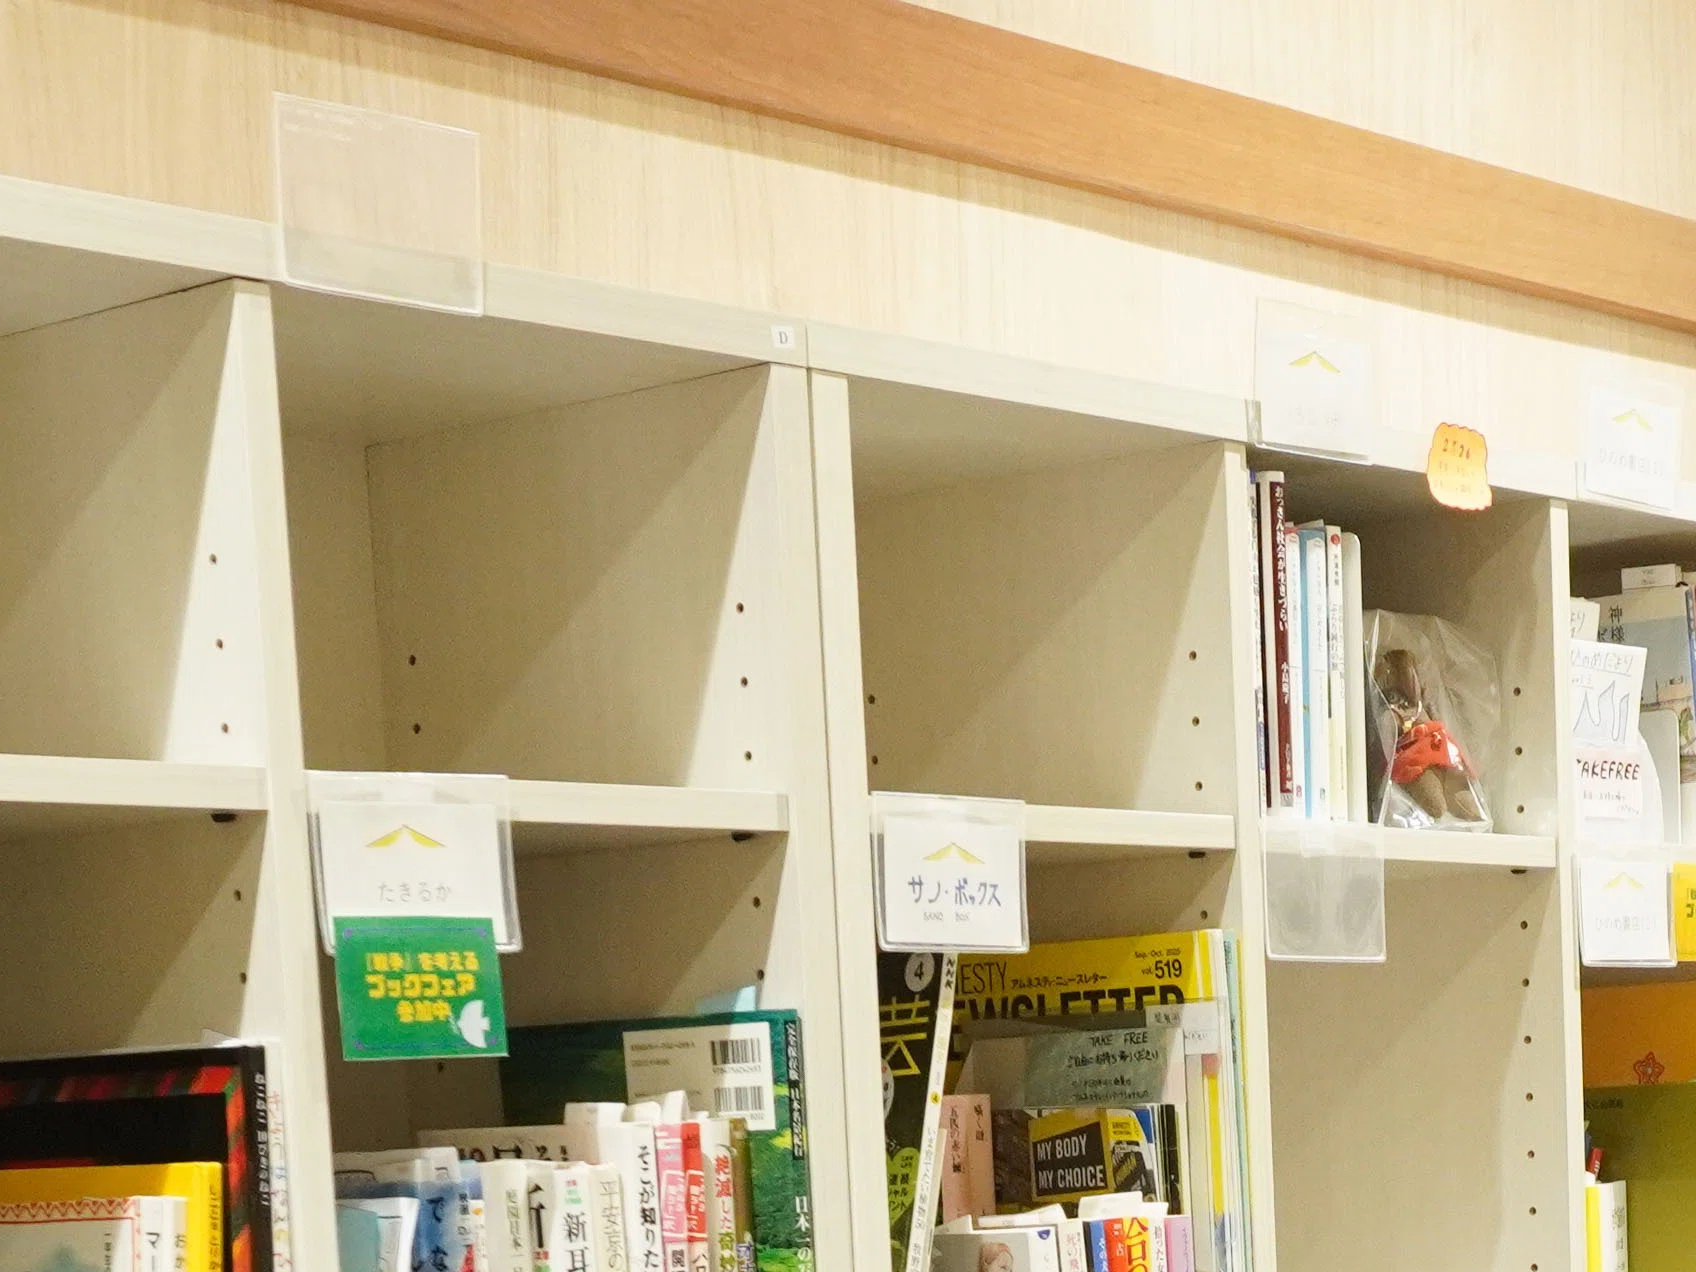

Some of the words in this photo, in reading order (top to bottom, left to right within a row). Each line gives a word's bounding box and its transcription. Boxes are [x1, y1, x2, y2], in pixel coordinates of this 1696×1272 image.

[913, 961, 924, 982] 4
[1154, 958, 1183, 979] 519
[365, 974, 477, 999] ブックフェア
[396, 999, 453, 1022] 参加中
[1123, 1031, 1149, 1045] FREE
[1037, 1139, 1059, 1160] MY
[1062, 1133, 1088, 1159] BODY
[1037, 1169, 1059, 1191] MY
[1059, 1164, 1105, 1190] CHOICE
